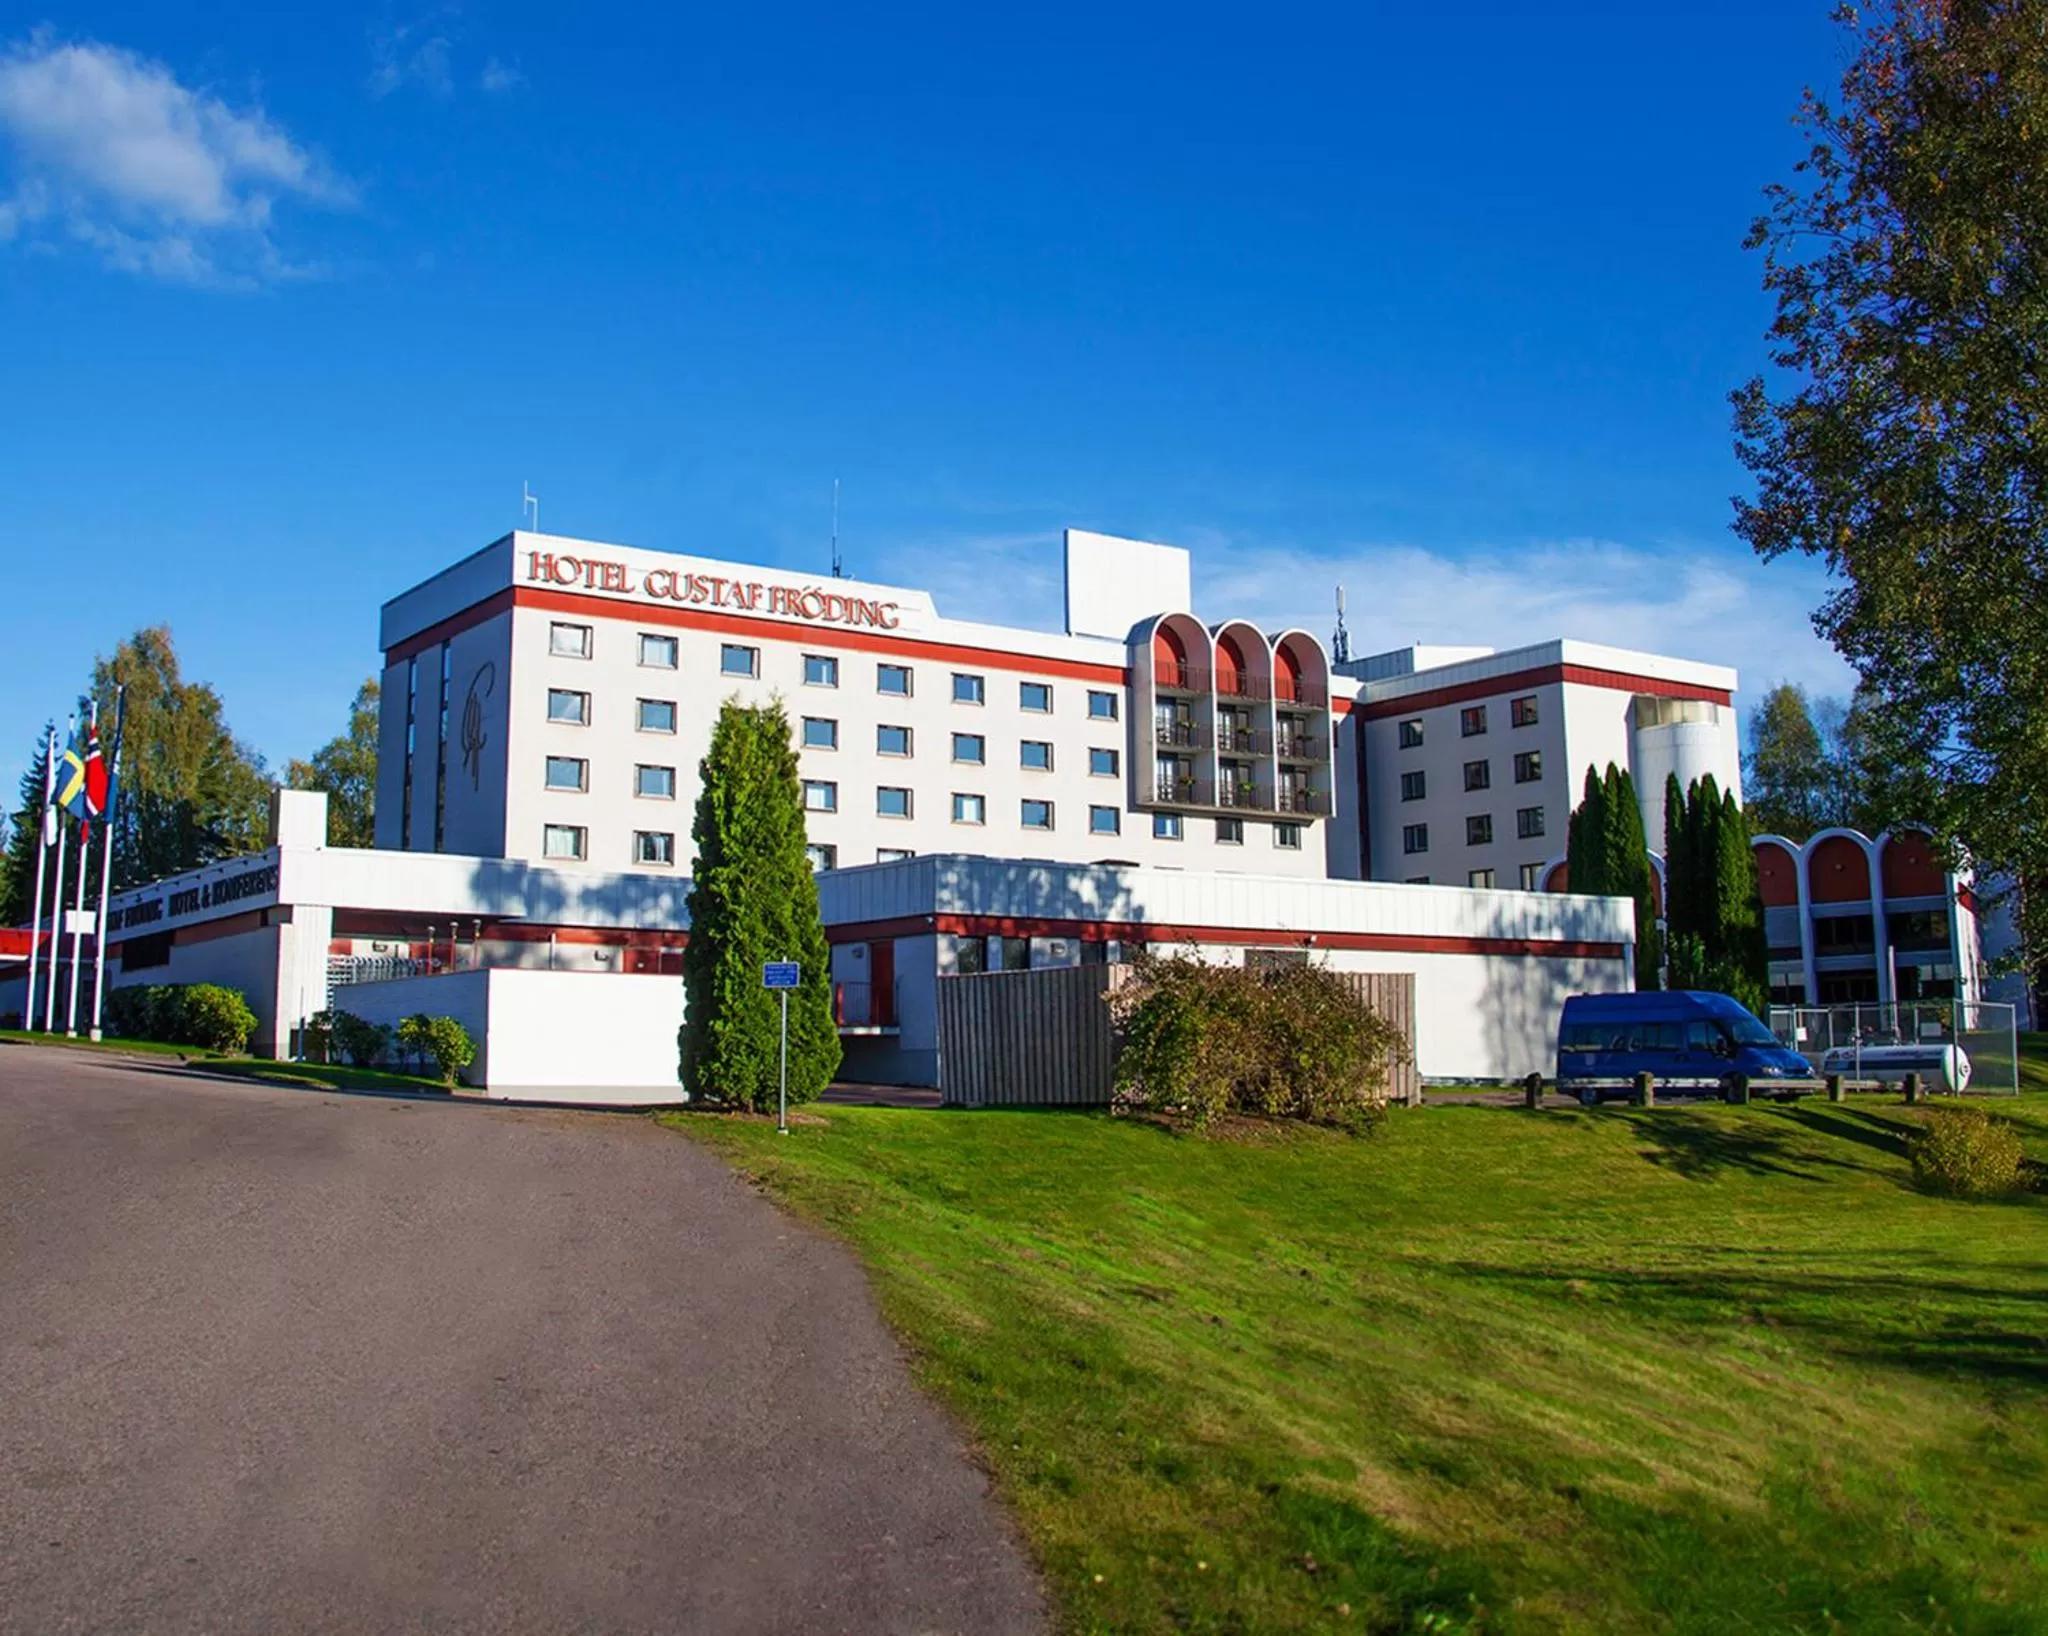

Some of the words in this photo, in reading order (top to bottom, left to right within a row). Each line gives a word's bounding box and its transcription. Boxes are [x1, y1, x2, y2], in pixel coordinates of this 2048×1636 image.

[527, 550, 636, 593] HOTEL
[643, 569, 763, 610] GUSTAF
[767, 585, 899, 629] FRÖDING
